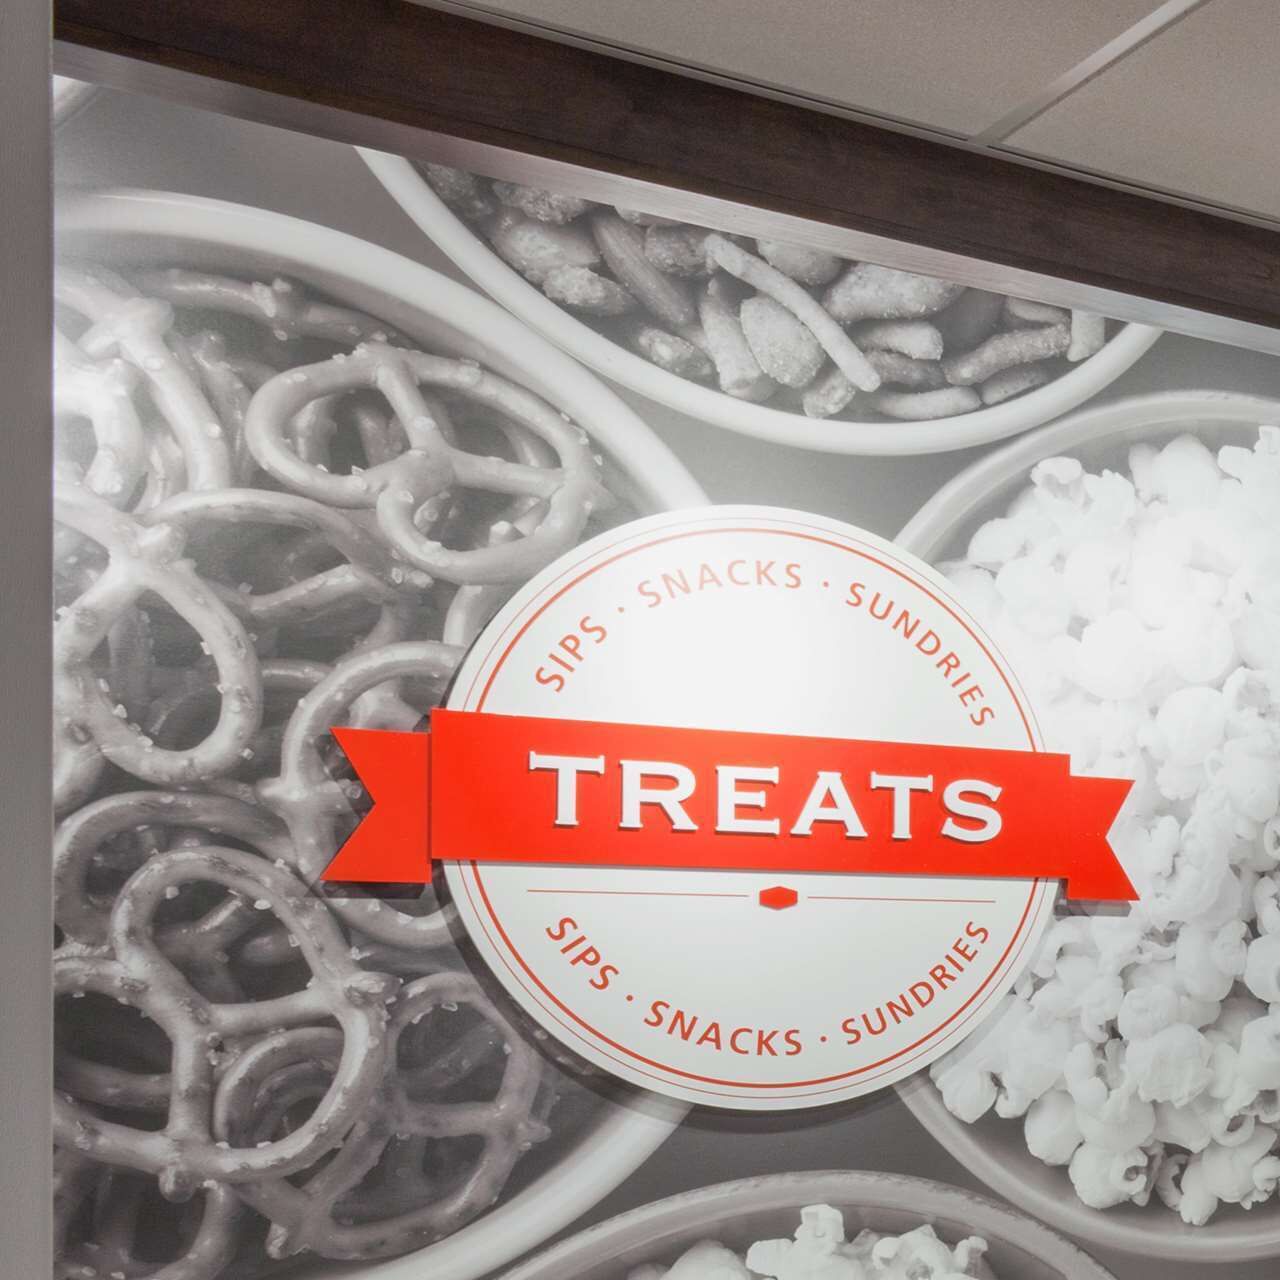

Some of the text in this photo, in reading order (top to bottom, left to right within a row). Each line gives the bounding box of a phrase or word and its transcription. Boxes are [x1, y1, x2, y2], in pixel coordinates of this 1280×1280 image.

[534, 558, 997, 728] SIPS SNACKS SUNDRIES
[528, 750, 1004, 843] TREATS
[546, 916, 991, 1057] SIPS SNACKS SUNDRIES
